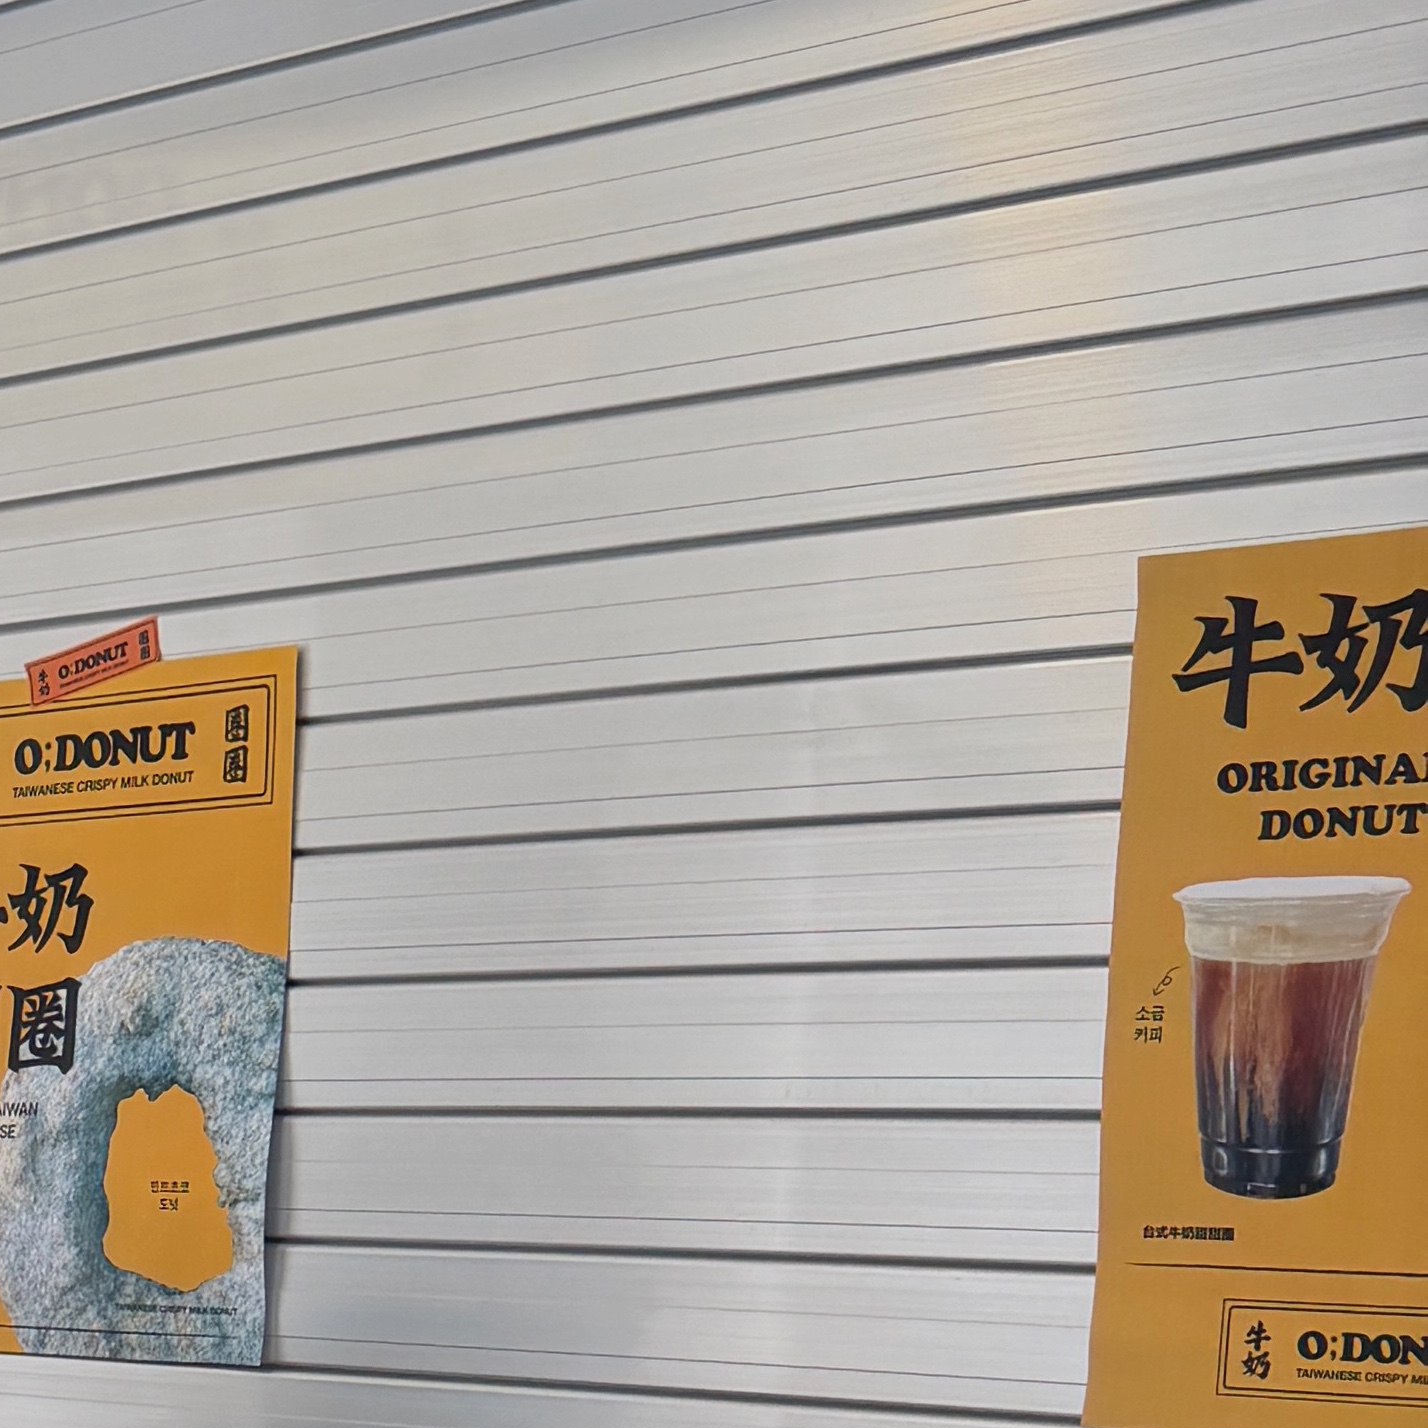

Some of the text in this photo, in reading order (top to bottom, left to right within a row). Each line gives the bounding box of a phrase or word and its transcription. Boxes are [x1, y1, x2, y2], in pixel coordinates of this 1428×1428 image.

[1171, 588, 1428, 731] 牛奶
[14, 721, 196, 776] O;DONUT
[13, 770, 195, 799] TAIWANESE CRISPY MILK DONUT
[1216, 752, 1428, 795] ORIGINA
[1257, 802, 1428, 841] DONUT
[1134, 1005, 1166, 1023] 소금
[1133, 1026, 1164, 1044] 커피
[1241, 1320, 1272, 1381] 牛奶
[1296, 1367, 1362, 1382] TAIWANESE
[1365, 1371, 1409, 1385] CRISPY
